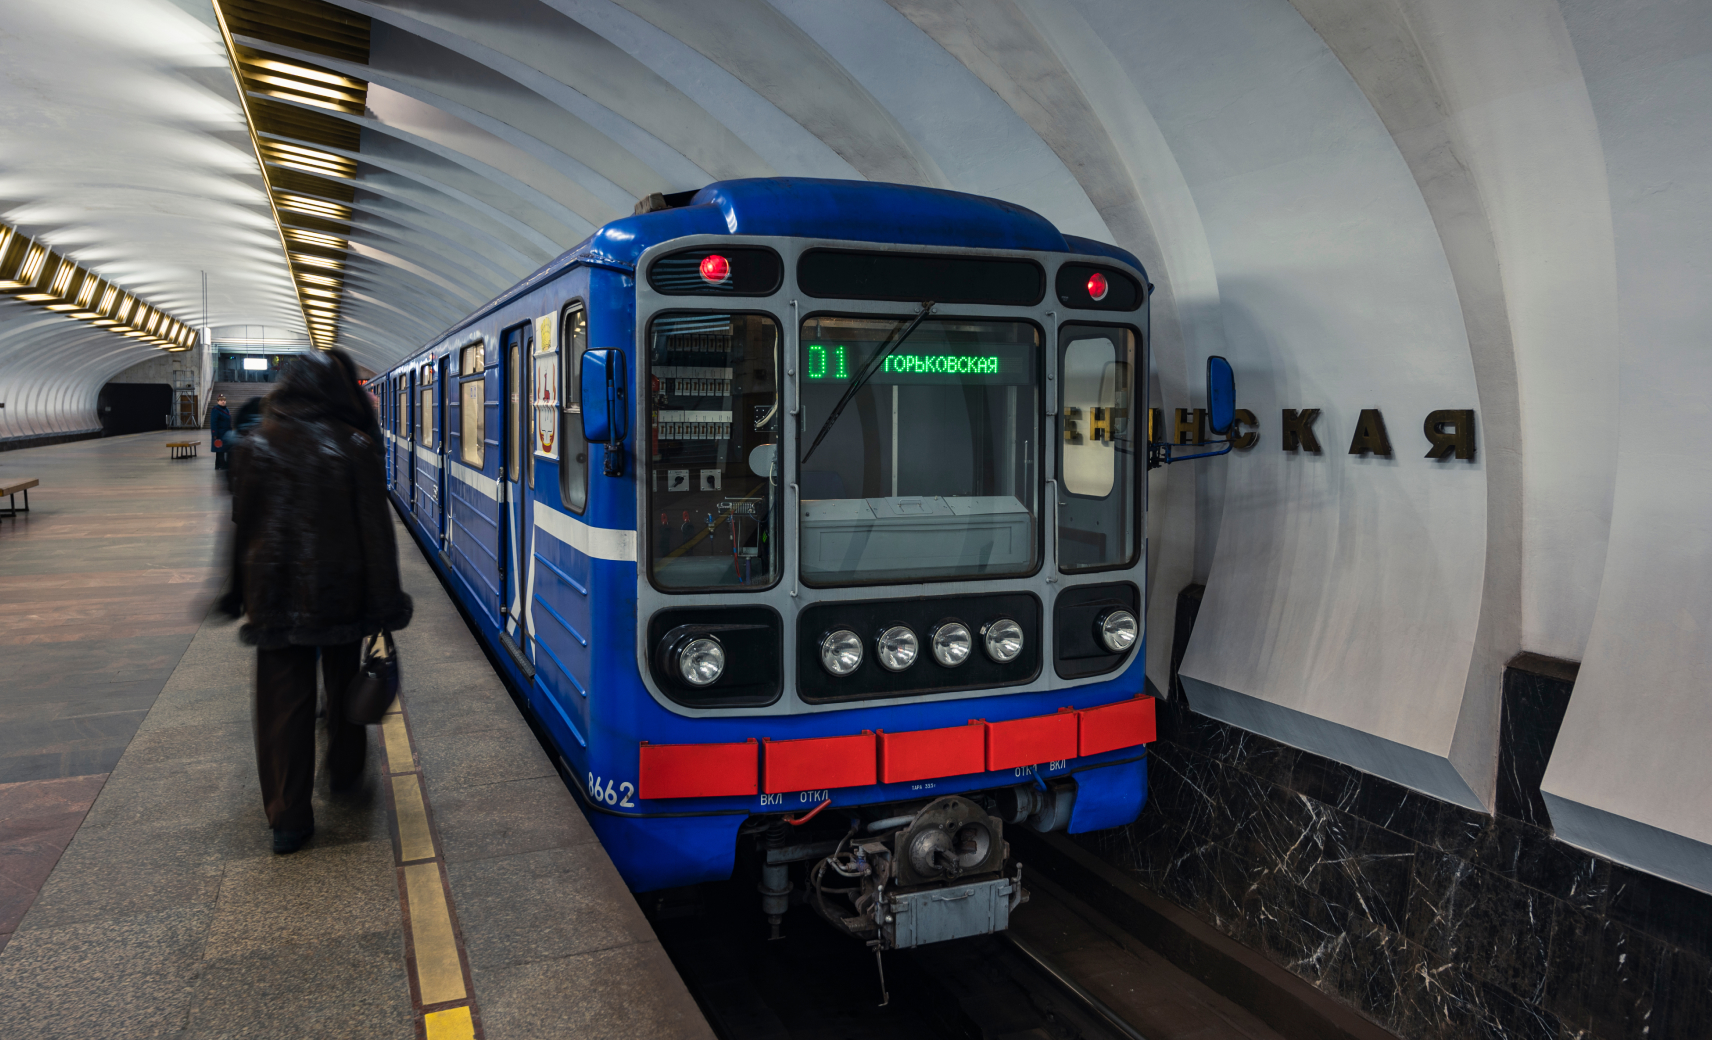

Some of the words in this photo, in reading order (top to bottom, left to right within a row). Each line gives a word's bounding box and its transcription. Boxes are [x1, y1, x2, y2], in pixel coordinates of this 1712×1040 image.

[885, 354, 998, 374] ГОРЬКОВСКАЯ
[1049, 759, 1066, 771] ВКЛ
[588, 771, 635, 808] 8662
[760, 793, 783, 806] ВКЛ
[800, 789, 829, 803] ОТКЛ
